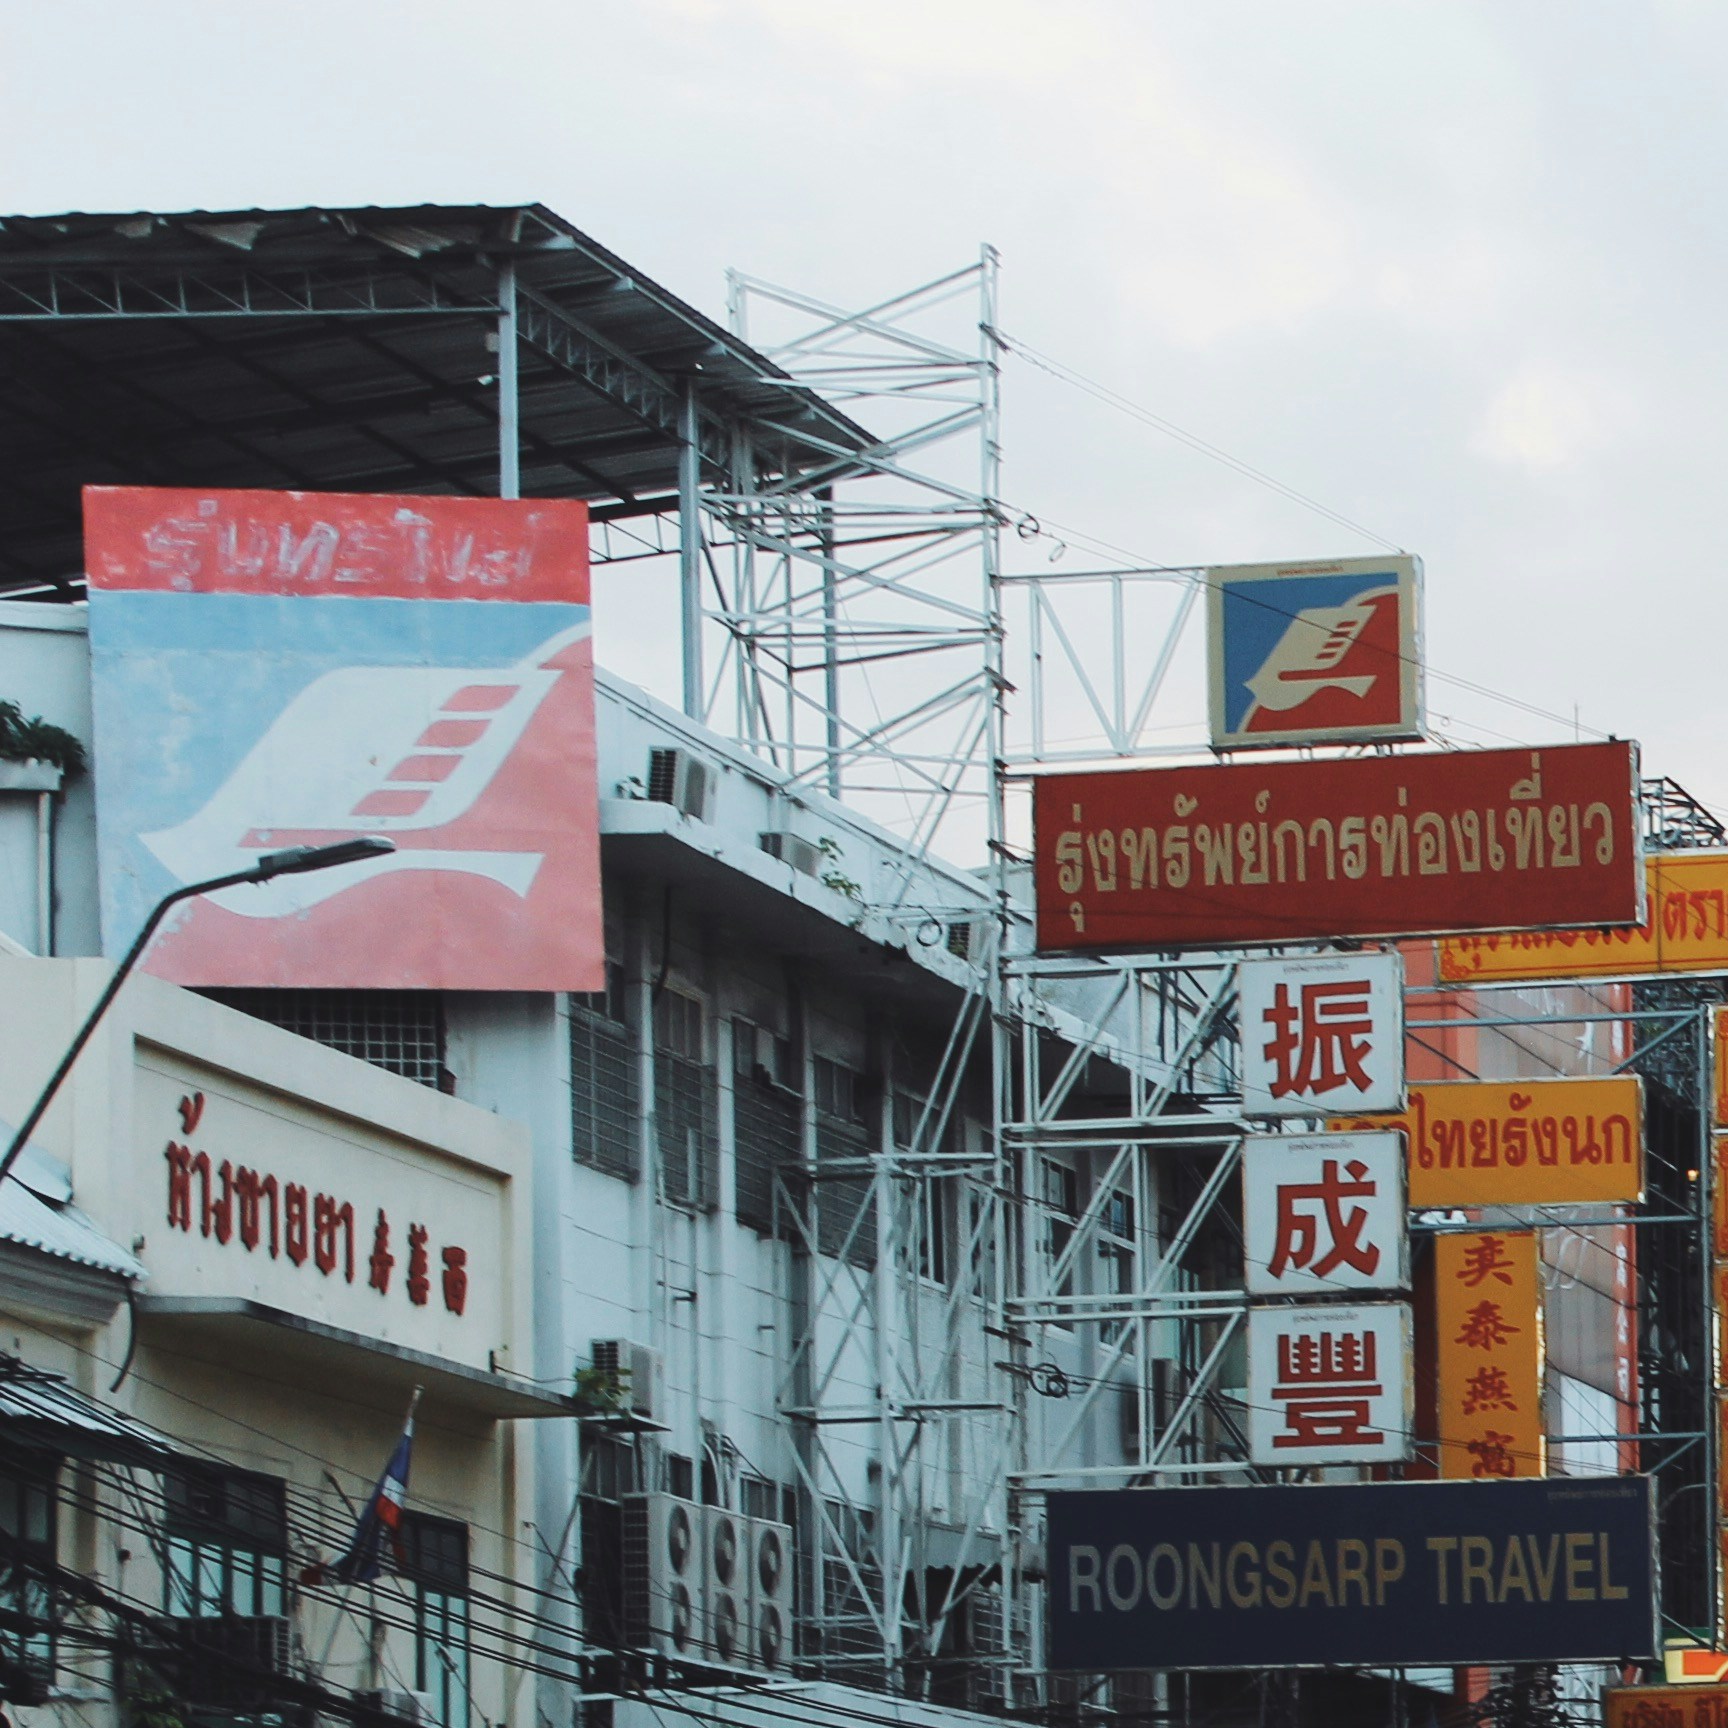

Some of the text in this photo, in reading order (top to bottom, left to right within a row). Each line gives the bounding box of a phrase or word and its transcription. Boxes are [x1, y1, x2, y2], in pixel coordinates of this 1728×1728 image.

[1261, 980, 1384, 1448] 振成豐
[1068, 1530, 1629, 1613] ROONGSARP TRAVEL
